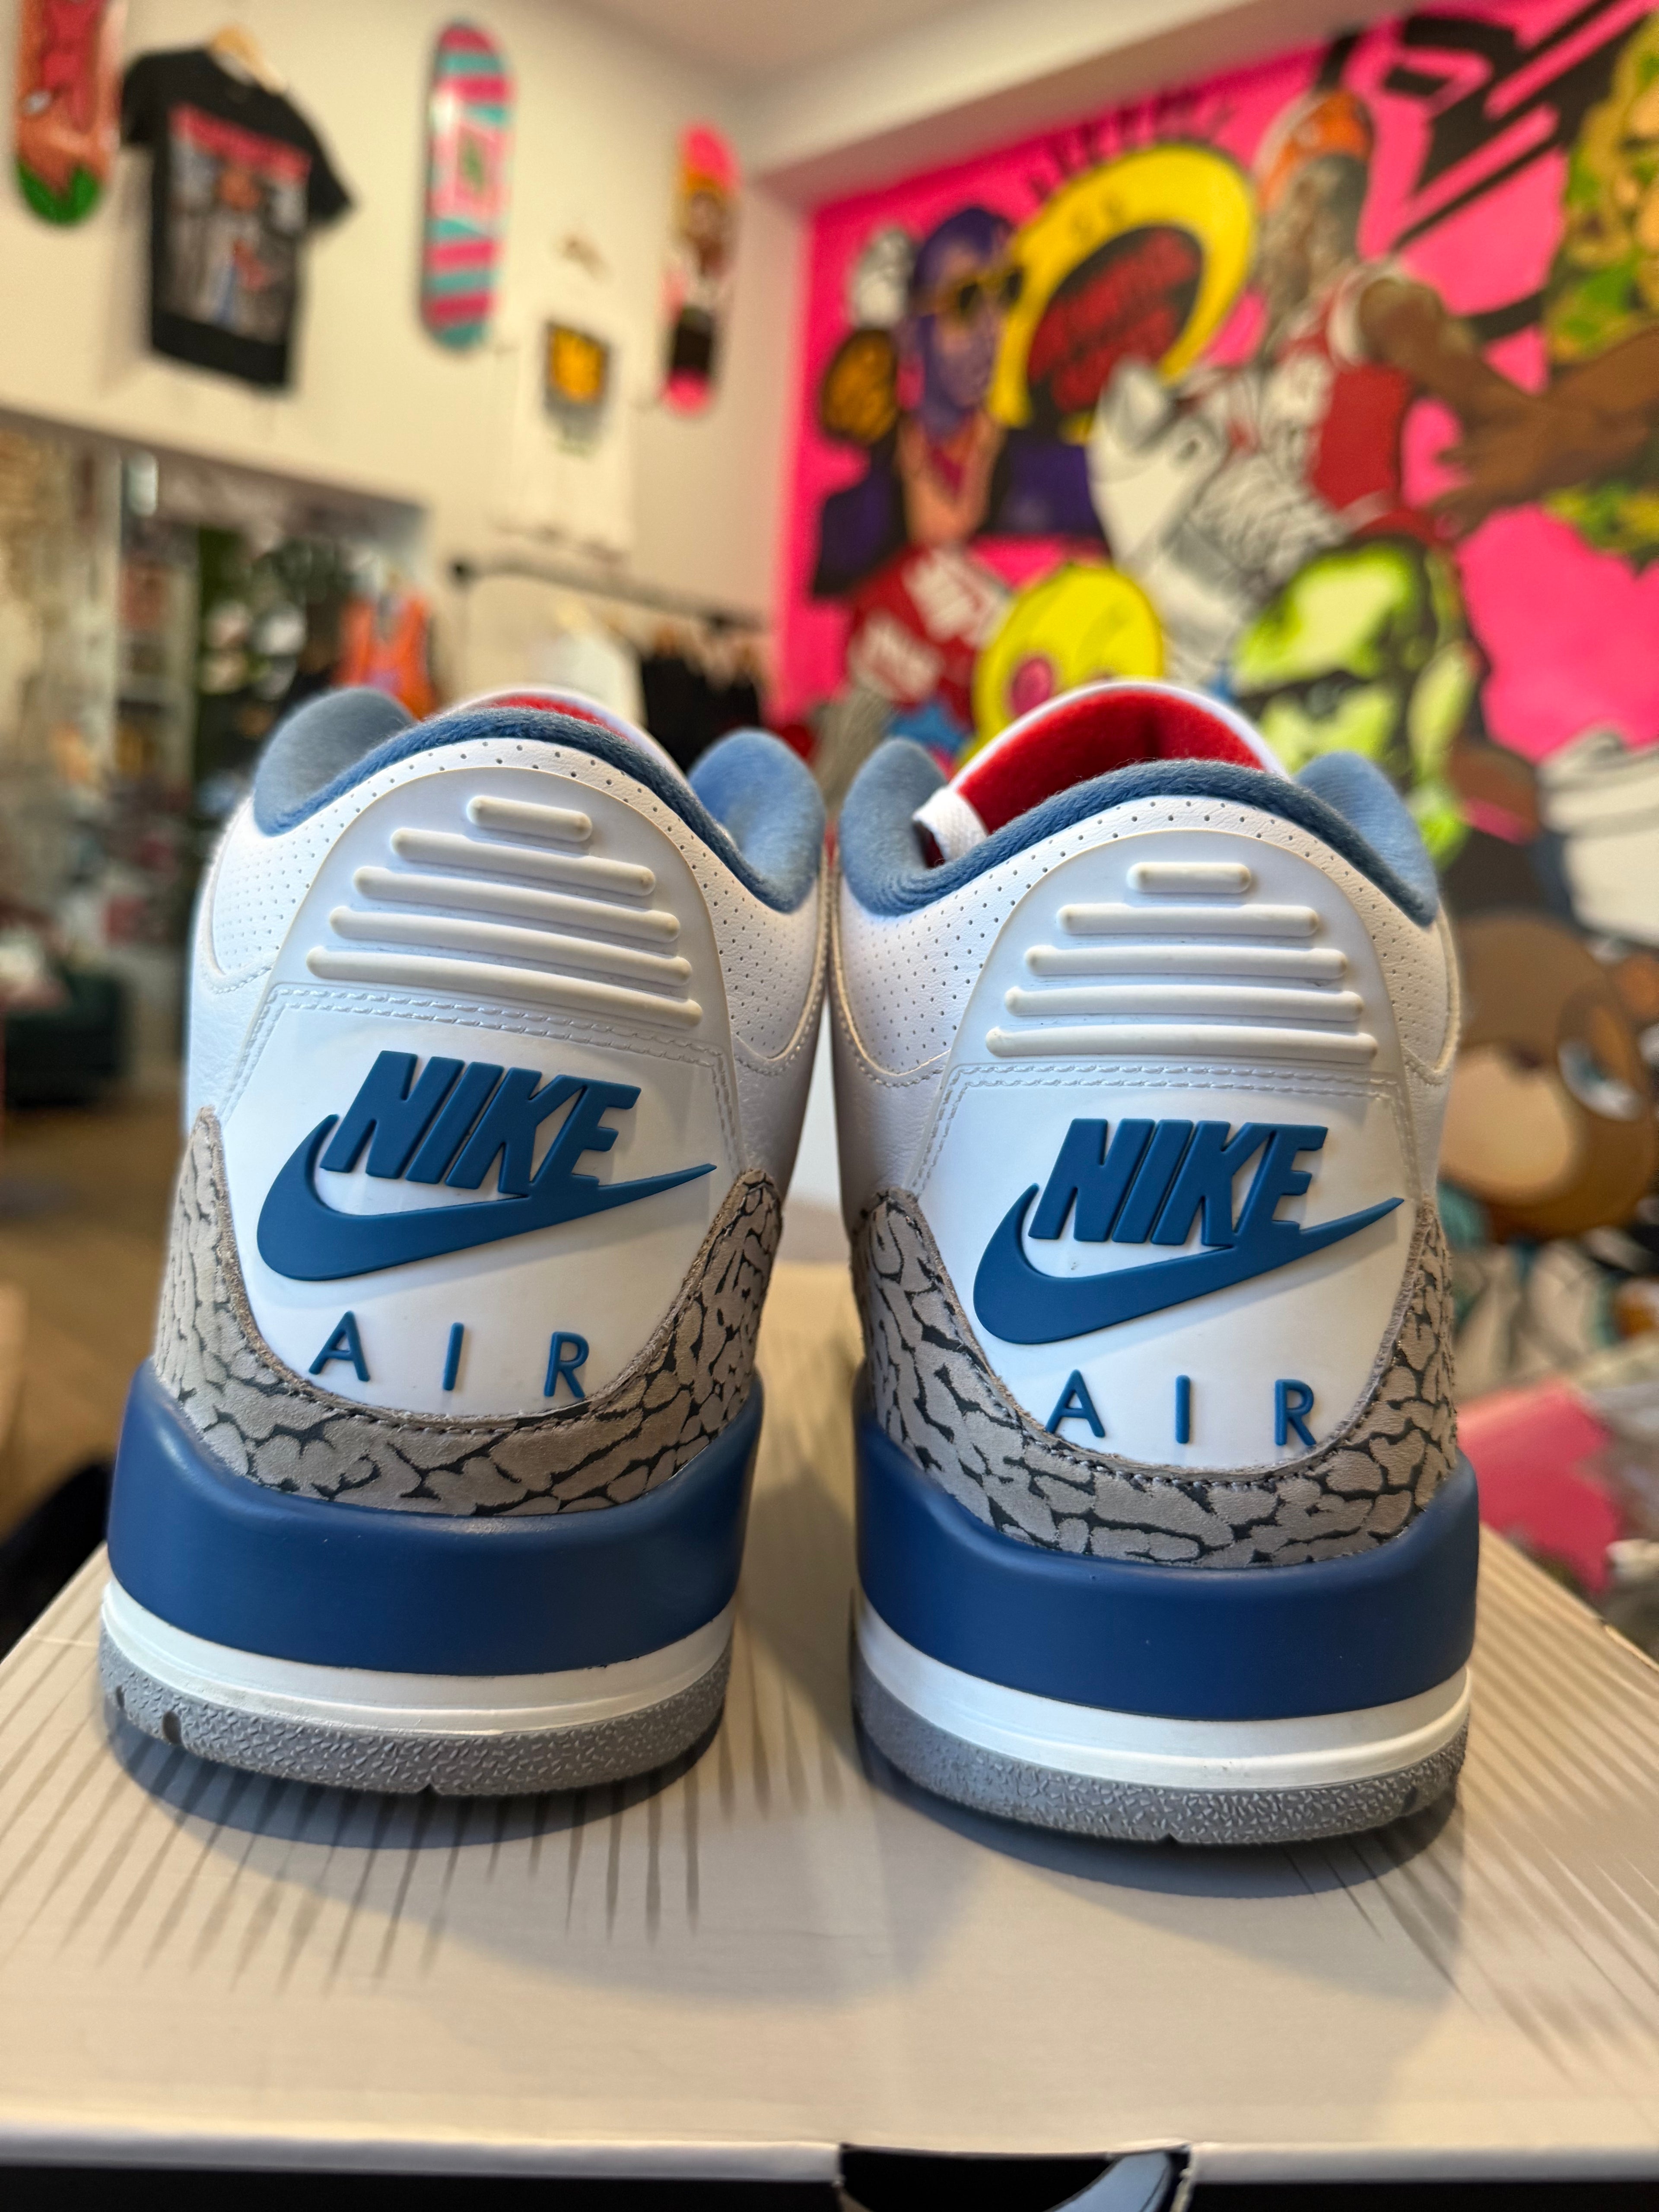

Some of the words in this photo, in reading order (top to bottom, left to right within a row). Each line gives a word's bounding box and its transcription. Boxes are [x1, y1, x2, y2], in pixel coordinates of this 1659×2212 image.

[319, 1050, 642, 1195] NIKE
[1028, 1118, 1328, 1247] NIKE
[308, 1310, 590, 1399] AIR
[1046, 1369, 1316, 1446] AIR
